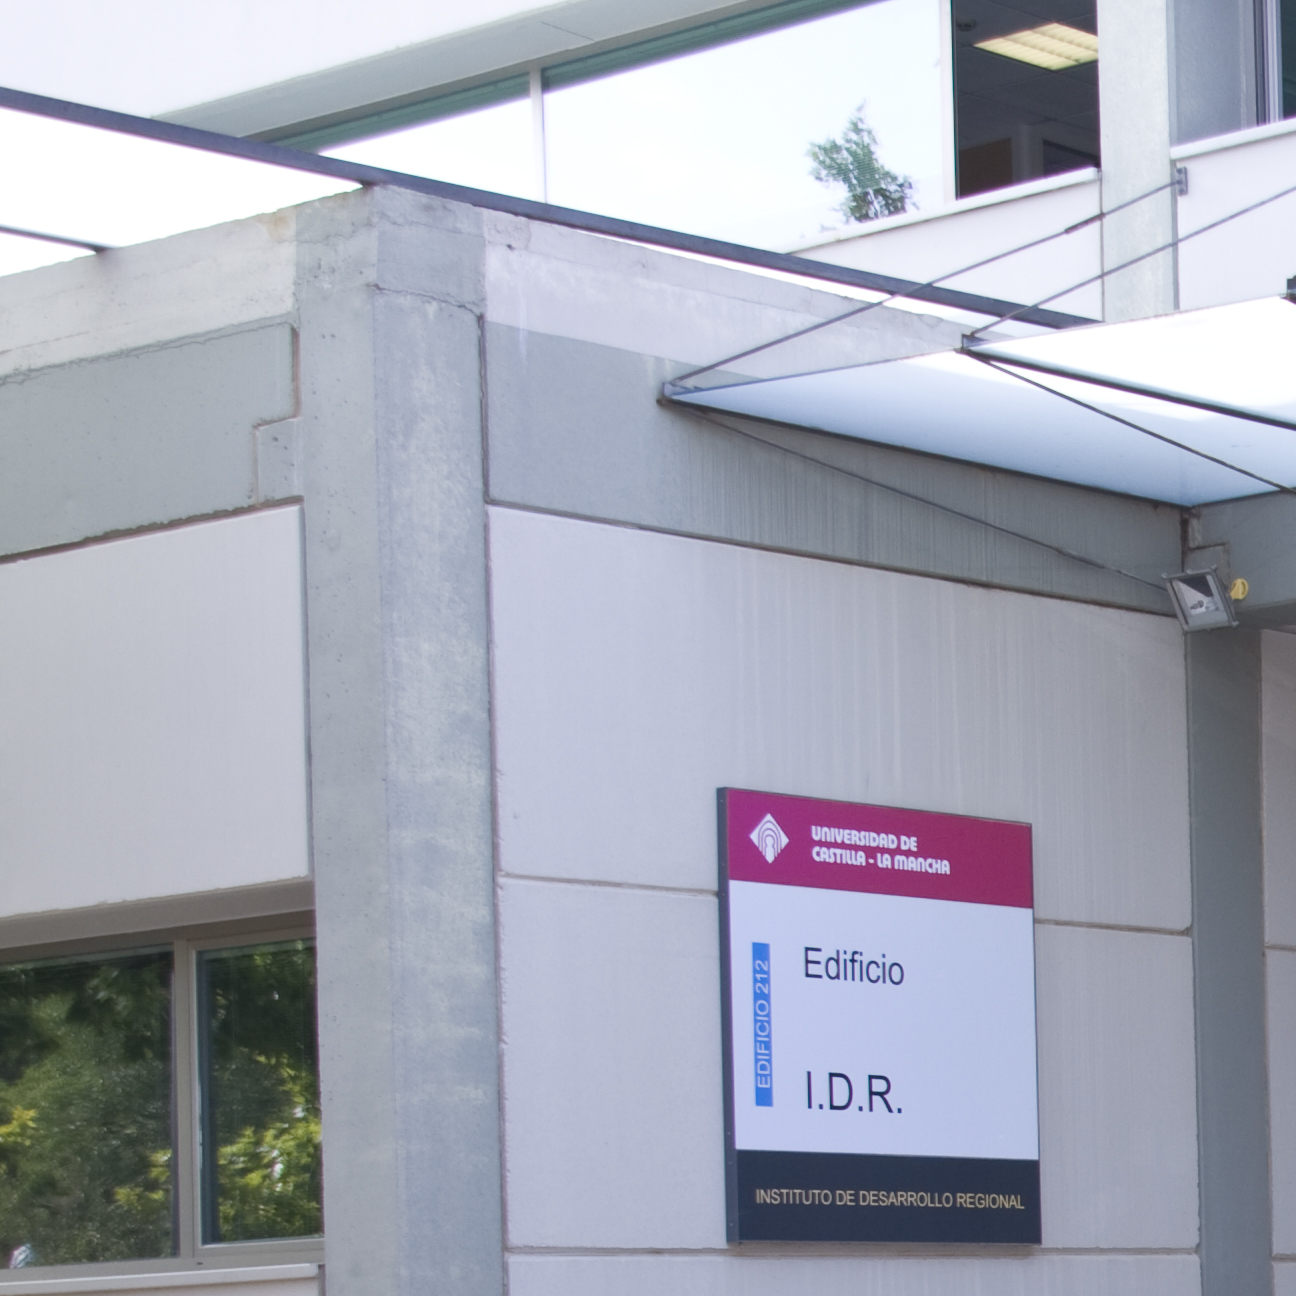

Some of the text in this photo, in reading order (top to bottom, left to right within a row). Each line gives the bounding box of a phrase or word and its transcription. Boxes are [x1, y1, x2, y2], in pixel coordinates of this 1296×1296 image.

[811, 825, 918, 852] UNIVERSIDAD DE
[812, 848, 866, 868] CASTILLA
[877, 853, 892, 870] LA
[894, 855, 951, 875] MANCHA
[803, 946, 905, 986] Edificio
[755, 959, 771, 1089] EDIFICIO 212
[806, 1070, 903, 1114] I.D.R.
[756, 1189, 1025, 1209] INSTITUTO DE DESARROLLO REGIONAL
